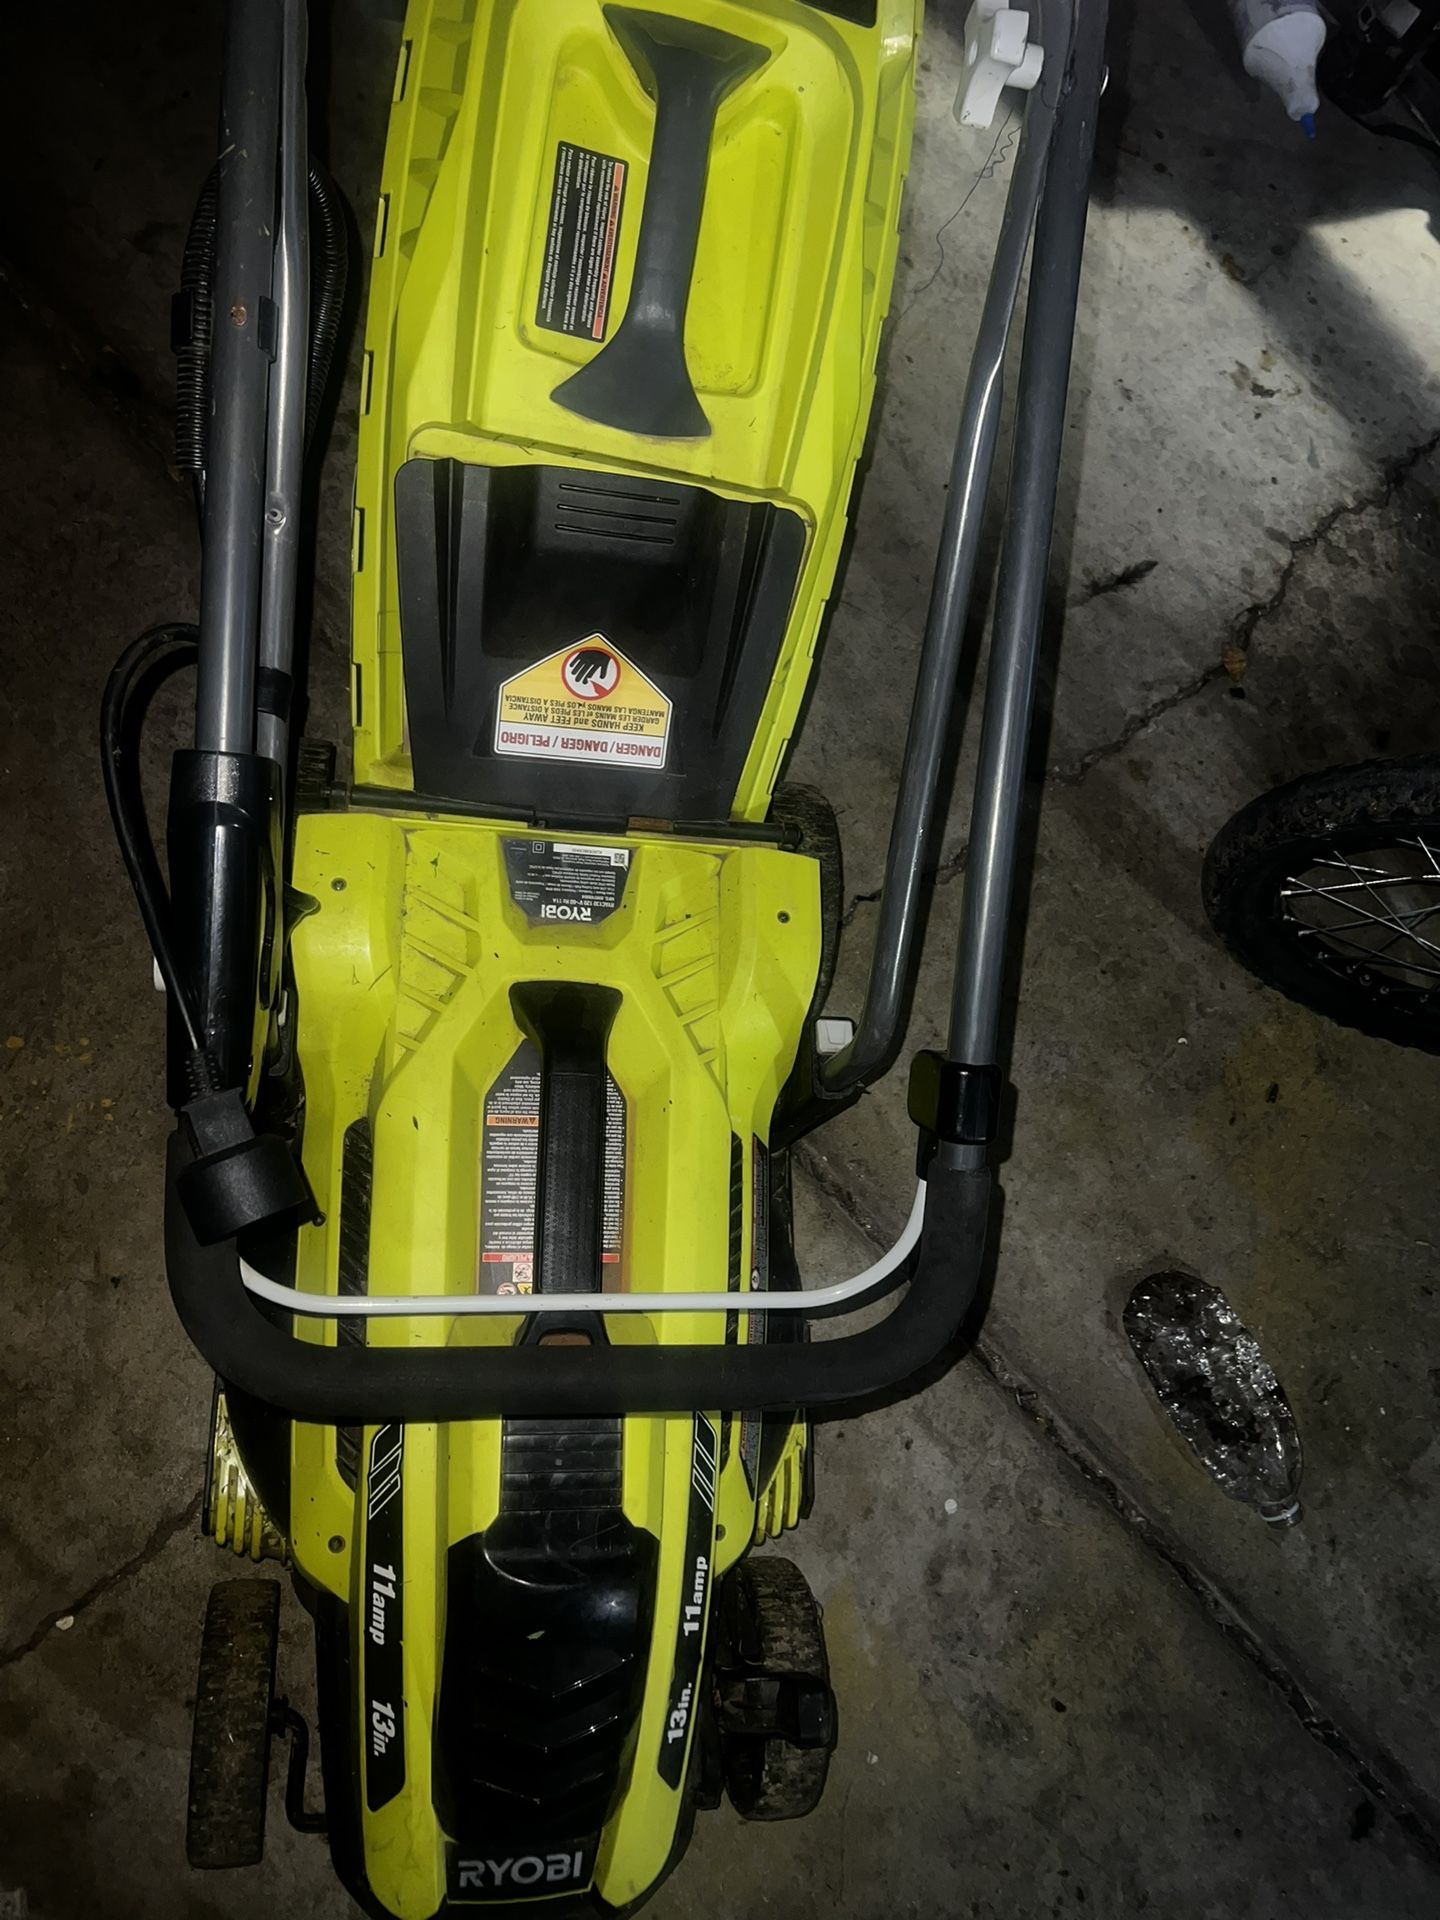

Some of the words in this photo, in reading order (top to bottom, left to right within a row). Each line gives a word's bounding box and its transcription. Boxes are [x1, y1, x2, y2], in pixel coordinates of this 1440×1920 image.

[610, 192, 618, 219] WARNING
[505, 694, 541, 705] DISTANCIA
[549, 699, 565, 707] PIES
[509, 703, 542, 712] DISTANCE
[567, 701, 582, 709] LOS
[588, 703, 612, 712] MANOS
[613, 706, 626, 714] LAS
[550, 707, 571, 715] PIEDS
[573, 709, 585, 717] LES
[595, 712, 616, 720] MAINS
[628, 708, 664, 718] MANTENGA
[523, 712, 548, 722] AWAY
[551, 715, 571, 725] FEET
[618, 714, 630, 722] LES
[632, 716, 659, 725] GARDER
[574, 718, 589, 727] and
[591, 719, 621, 730] HANDS
[623, 723, 644, 732] KEEP
[501, 731, 550, 747] PELIGRO
[561, 737, 608, 753] DANGER
[616, 743, 661, 758] DANGER
[540, 904, 592, 921] RYOBI
[683, 1556, 708, 1636] 11amp
[369, 1563, 396, 1645] 11amp
[668, 1682, 692, 1743] 13in.
[372, 1700, 395, 1756] 13in.
[458, 1851, 583, 1888] RYOBI
